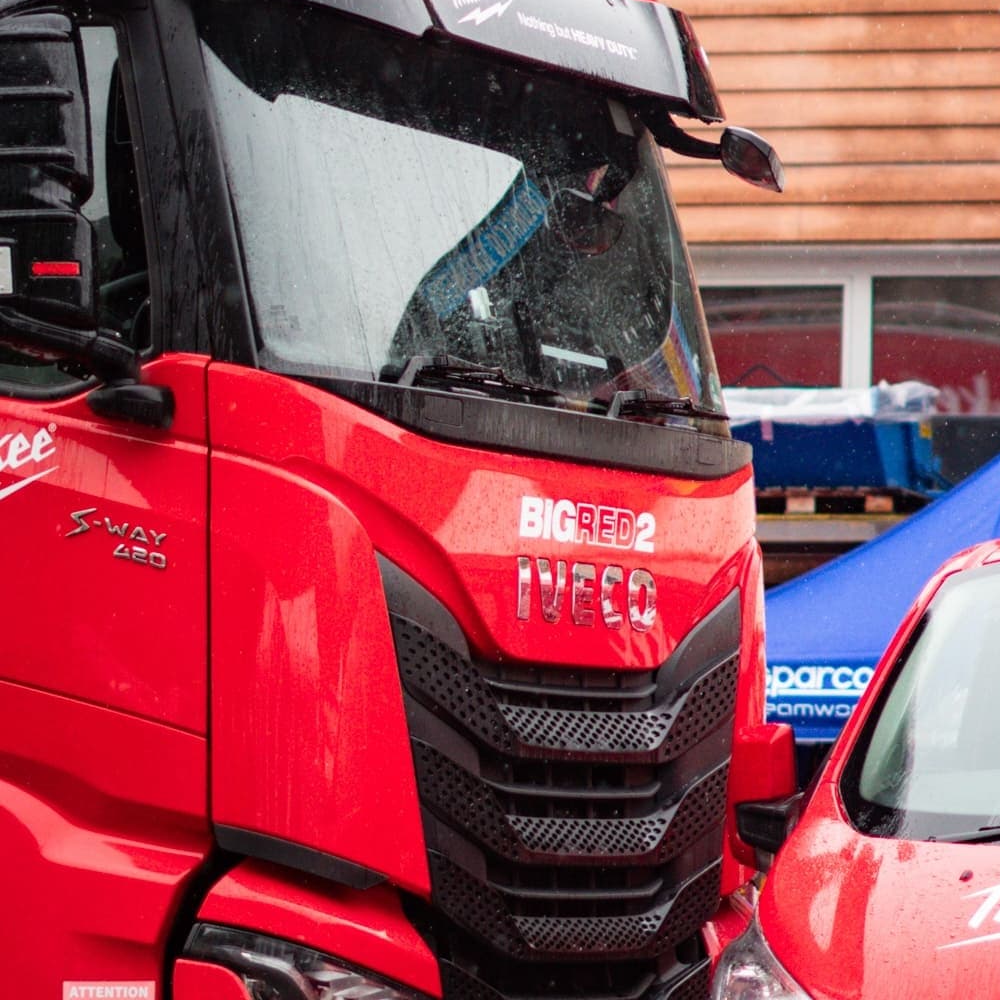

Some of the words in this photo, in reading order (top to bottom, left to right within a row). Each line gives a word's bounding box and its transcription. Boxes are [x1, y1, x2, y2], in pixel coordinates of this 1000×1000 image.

[516, 10, 555, 39] Nothing
[554, 23, 572, 40] but
[571, 27, 606, 51] HEAVY
[64, 507, 168, 547] S-WAY
[112, 543, 168, 570] 420
[517, 556, 657, 633] IVECO
[69, 985, 148, 999] ATTENTION
